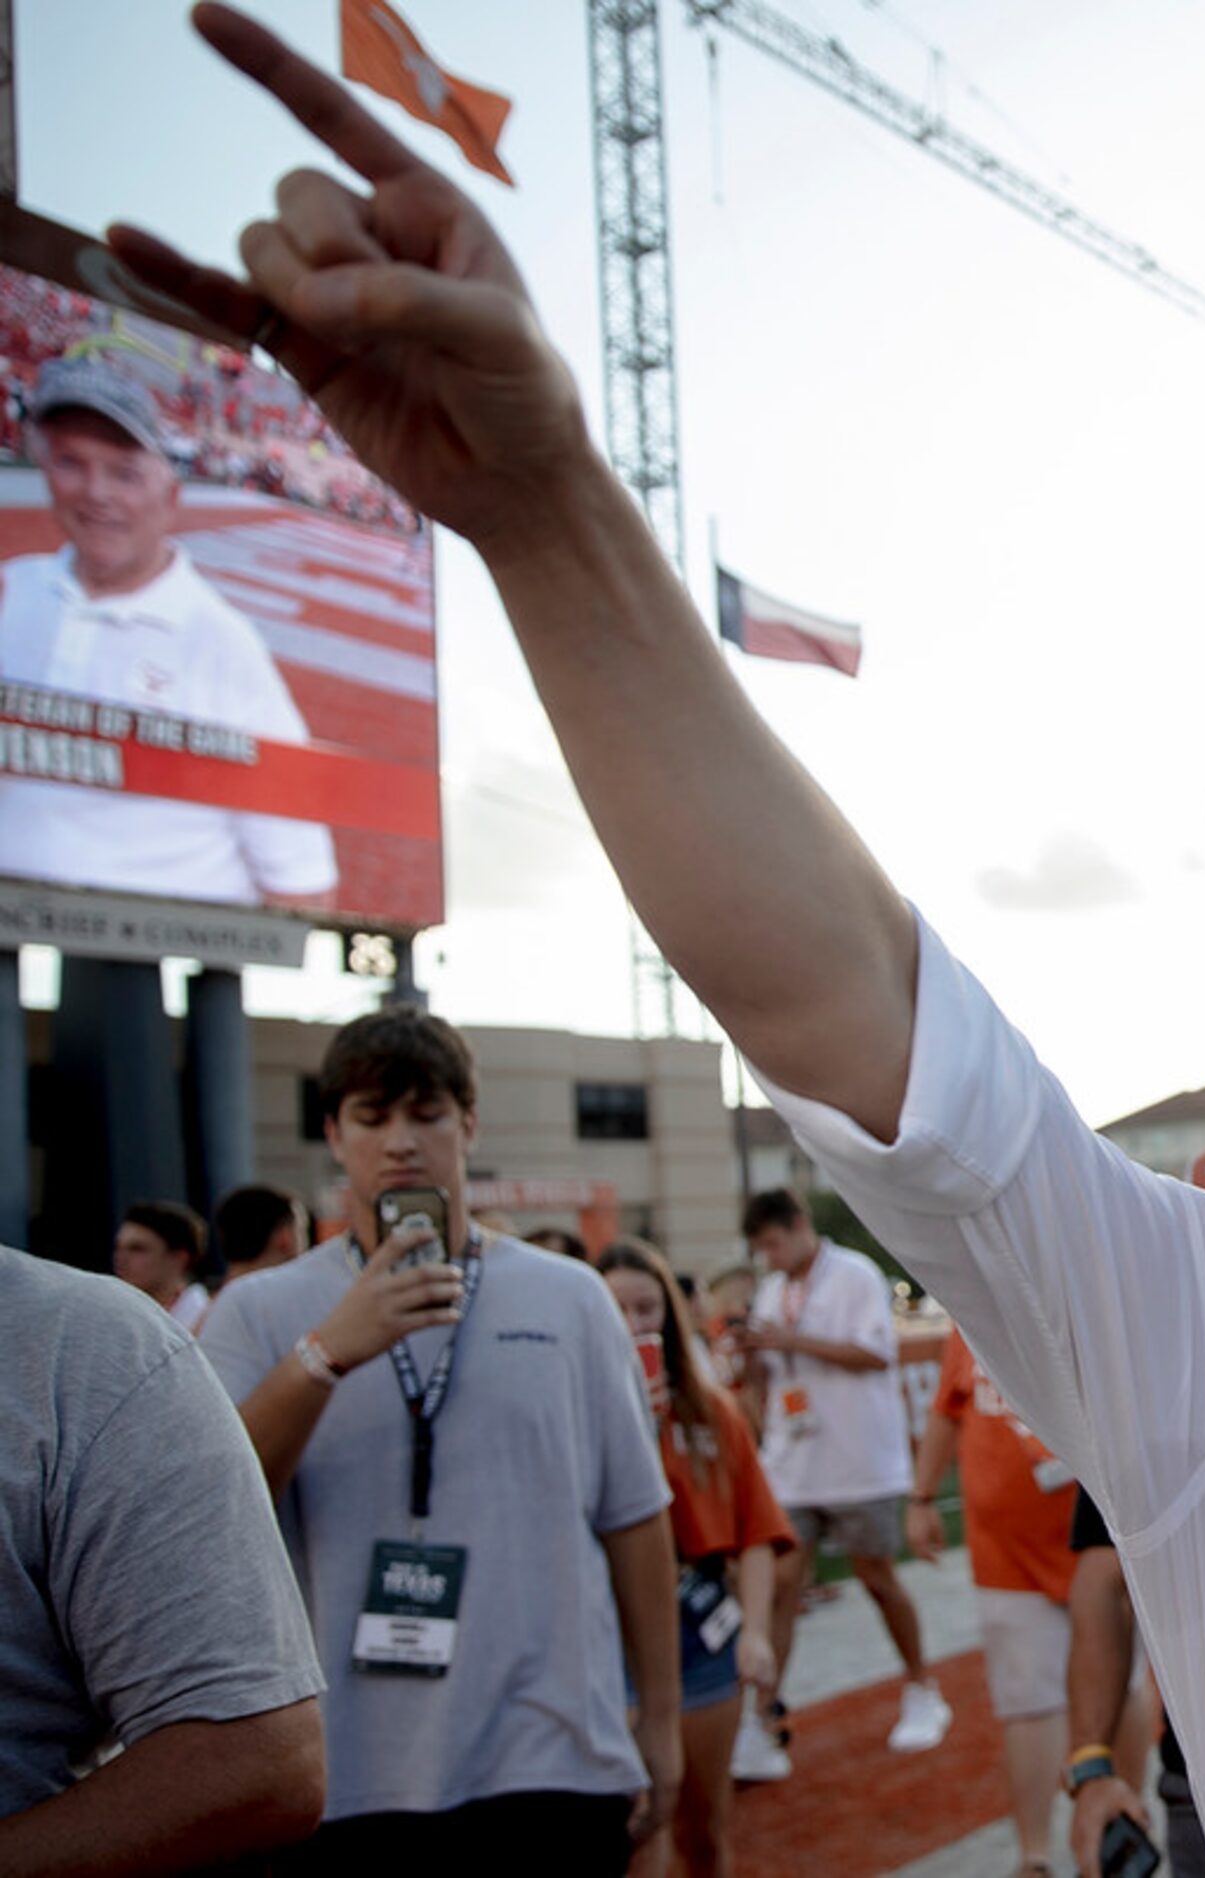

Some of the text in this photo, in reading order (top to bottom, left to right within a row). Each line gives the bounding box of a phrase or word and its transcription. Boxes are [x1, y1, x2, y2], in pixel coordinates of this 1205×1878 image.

[0, 683, 94, 734] TERAN
[97, 704, 131, 741] OF
[136, 712, 185, 752] THE
